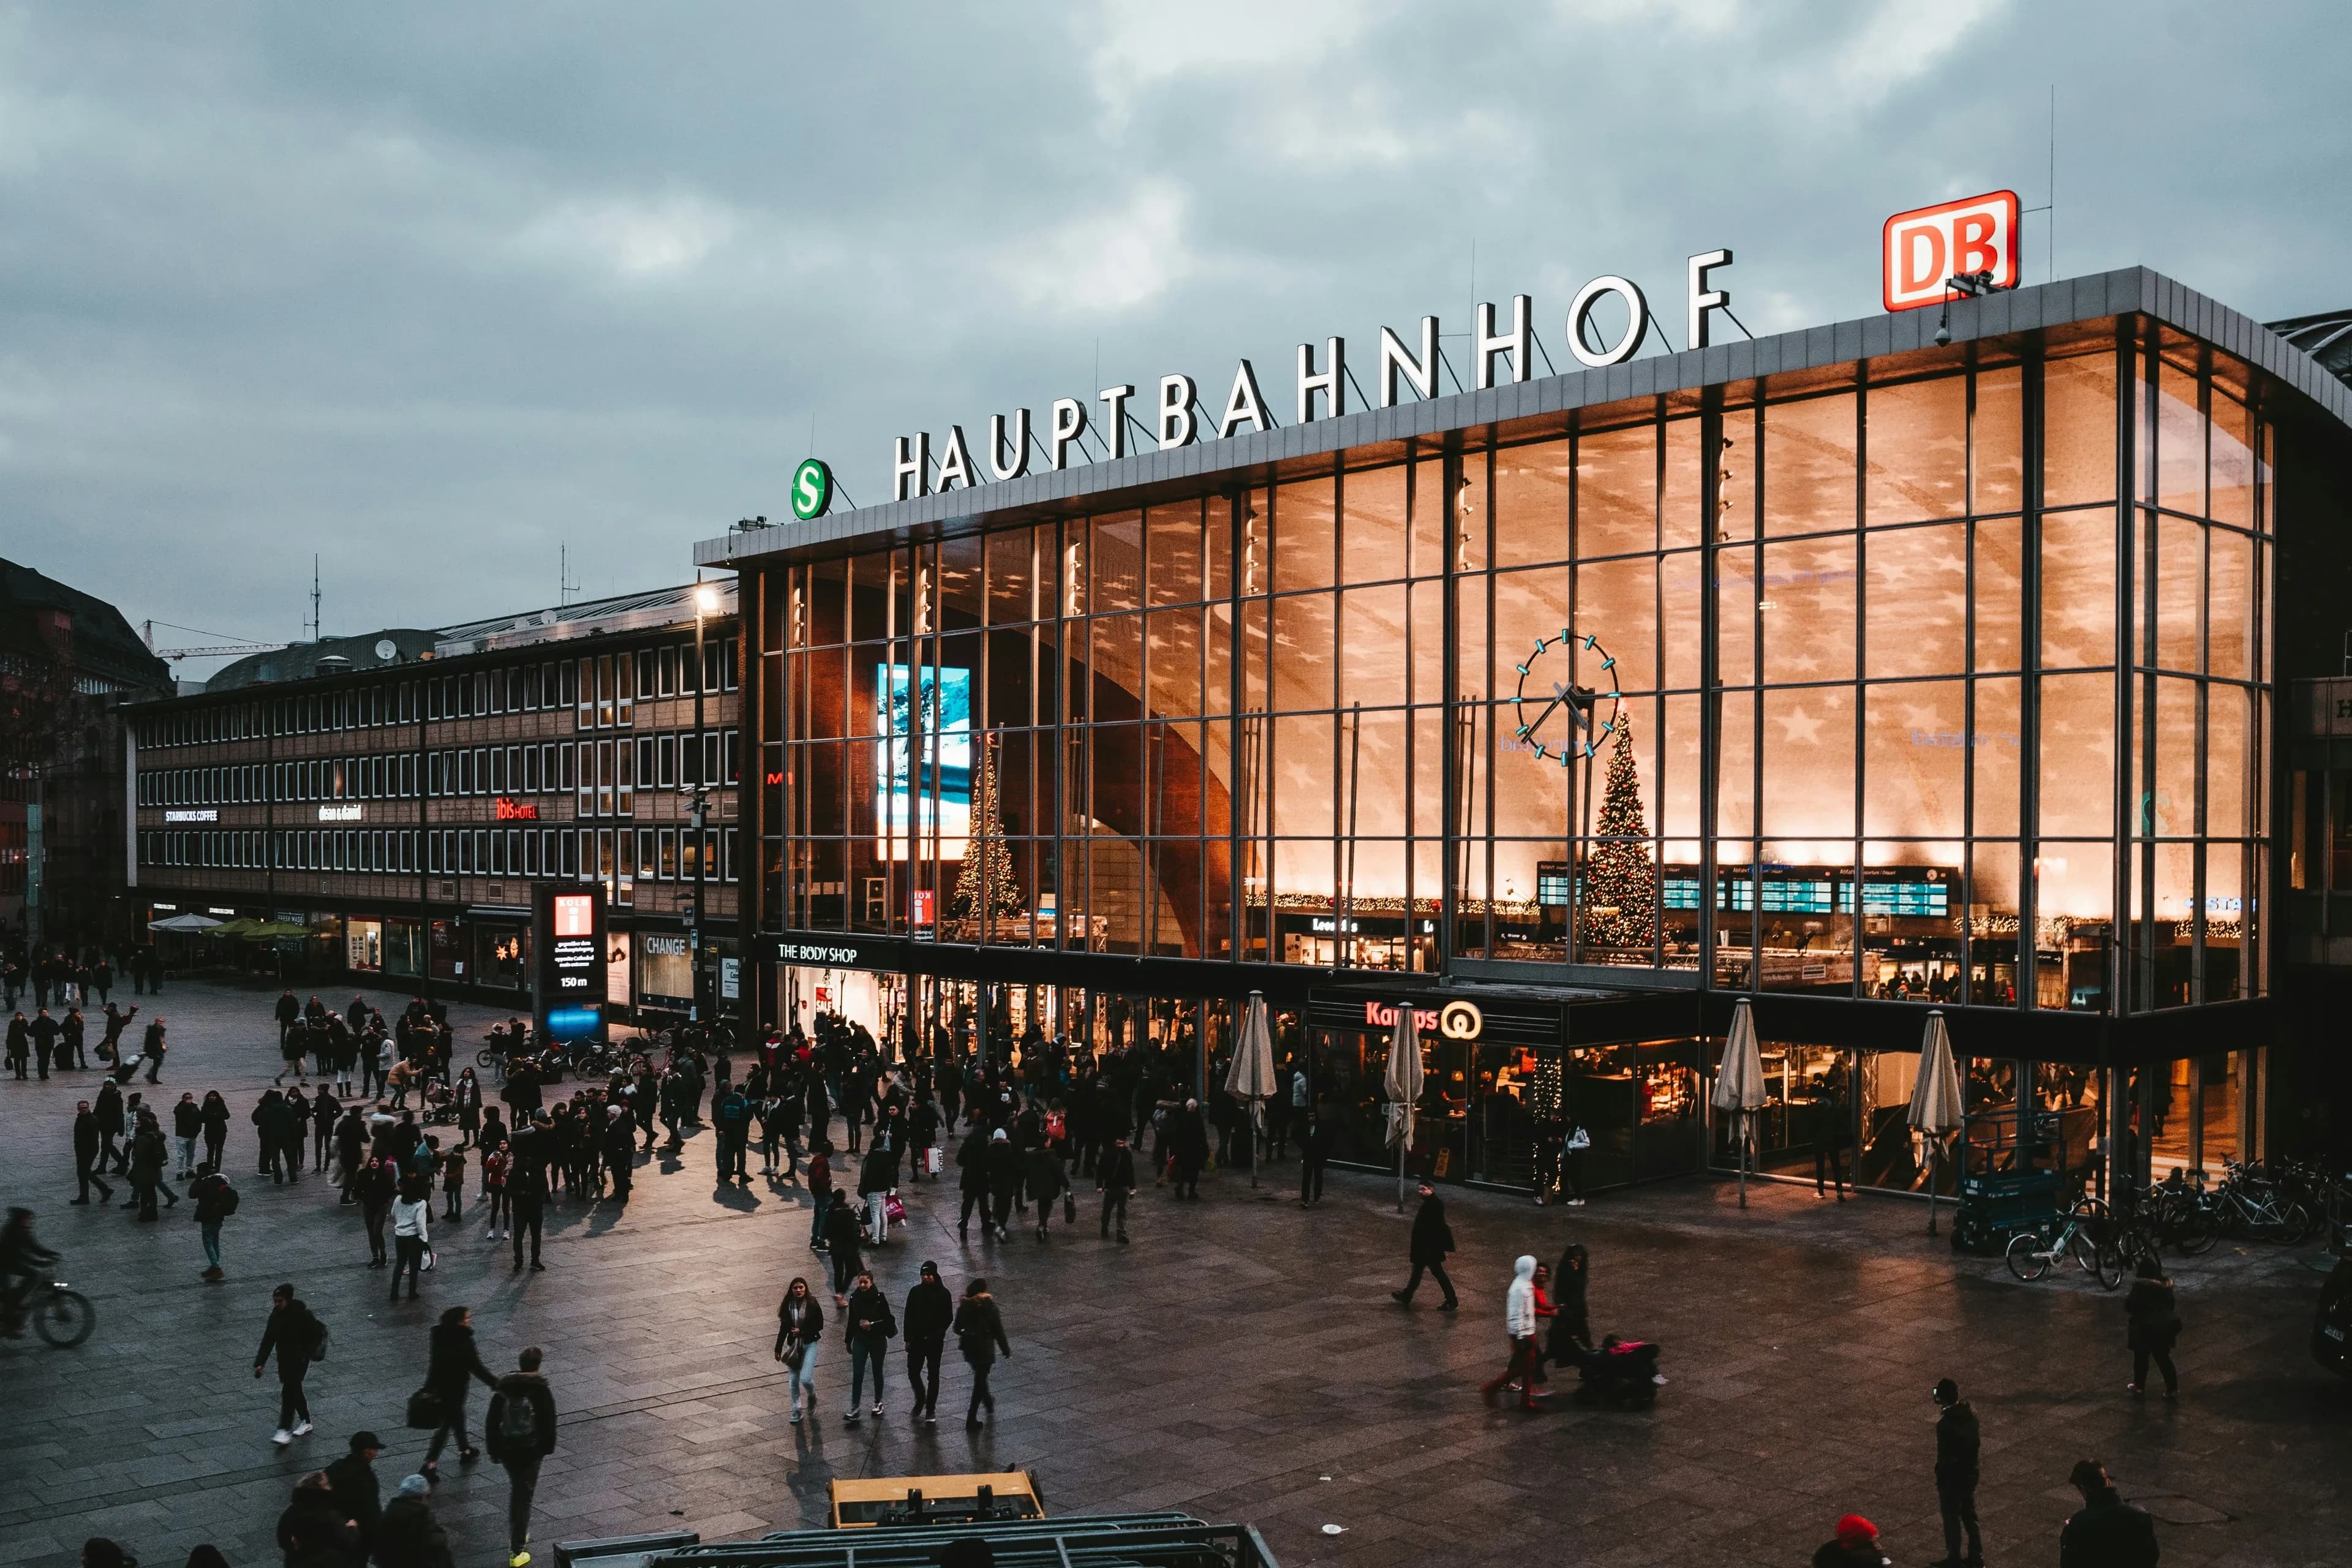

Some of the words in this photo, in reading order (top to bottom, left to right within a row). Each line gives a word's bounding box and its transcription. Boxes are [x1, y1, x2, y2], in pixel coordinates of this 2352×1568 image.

[1901, 213, 1997, 294] DB
[894, 249, 1733, 501] HAUPTBAHNHOF
[797, 466, 819, 513] S
[166, 811, 196, 821] STARBUCKS
[197, 810, 217, 821] COFFEE
[319, 805, 336, 820] dean
[342, 804, 361, 820] david
[497, 797, 514, 819] ibis
[514, 805, 537, 819] HOTEL
[647, 937, 685, 956] CHANGE
[778, 944, 797, 959] THE
[800, 946, 827, 960] BODY
[829, 948, 857, 963] SHOP
[561, 978, 576, 987] 150
[816, 1000, 832, 1011] SALE
